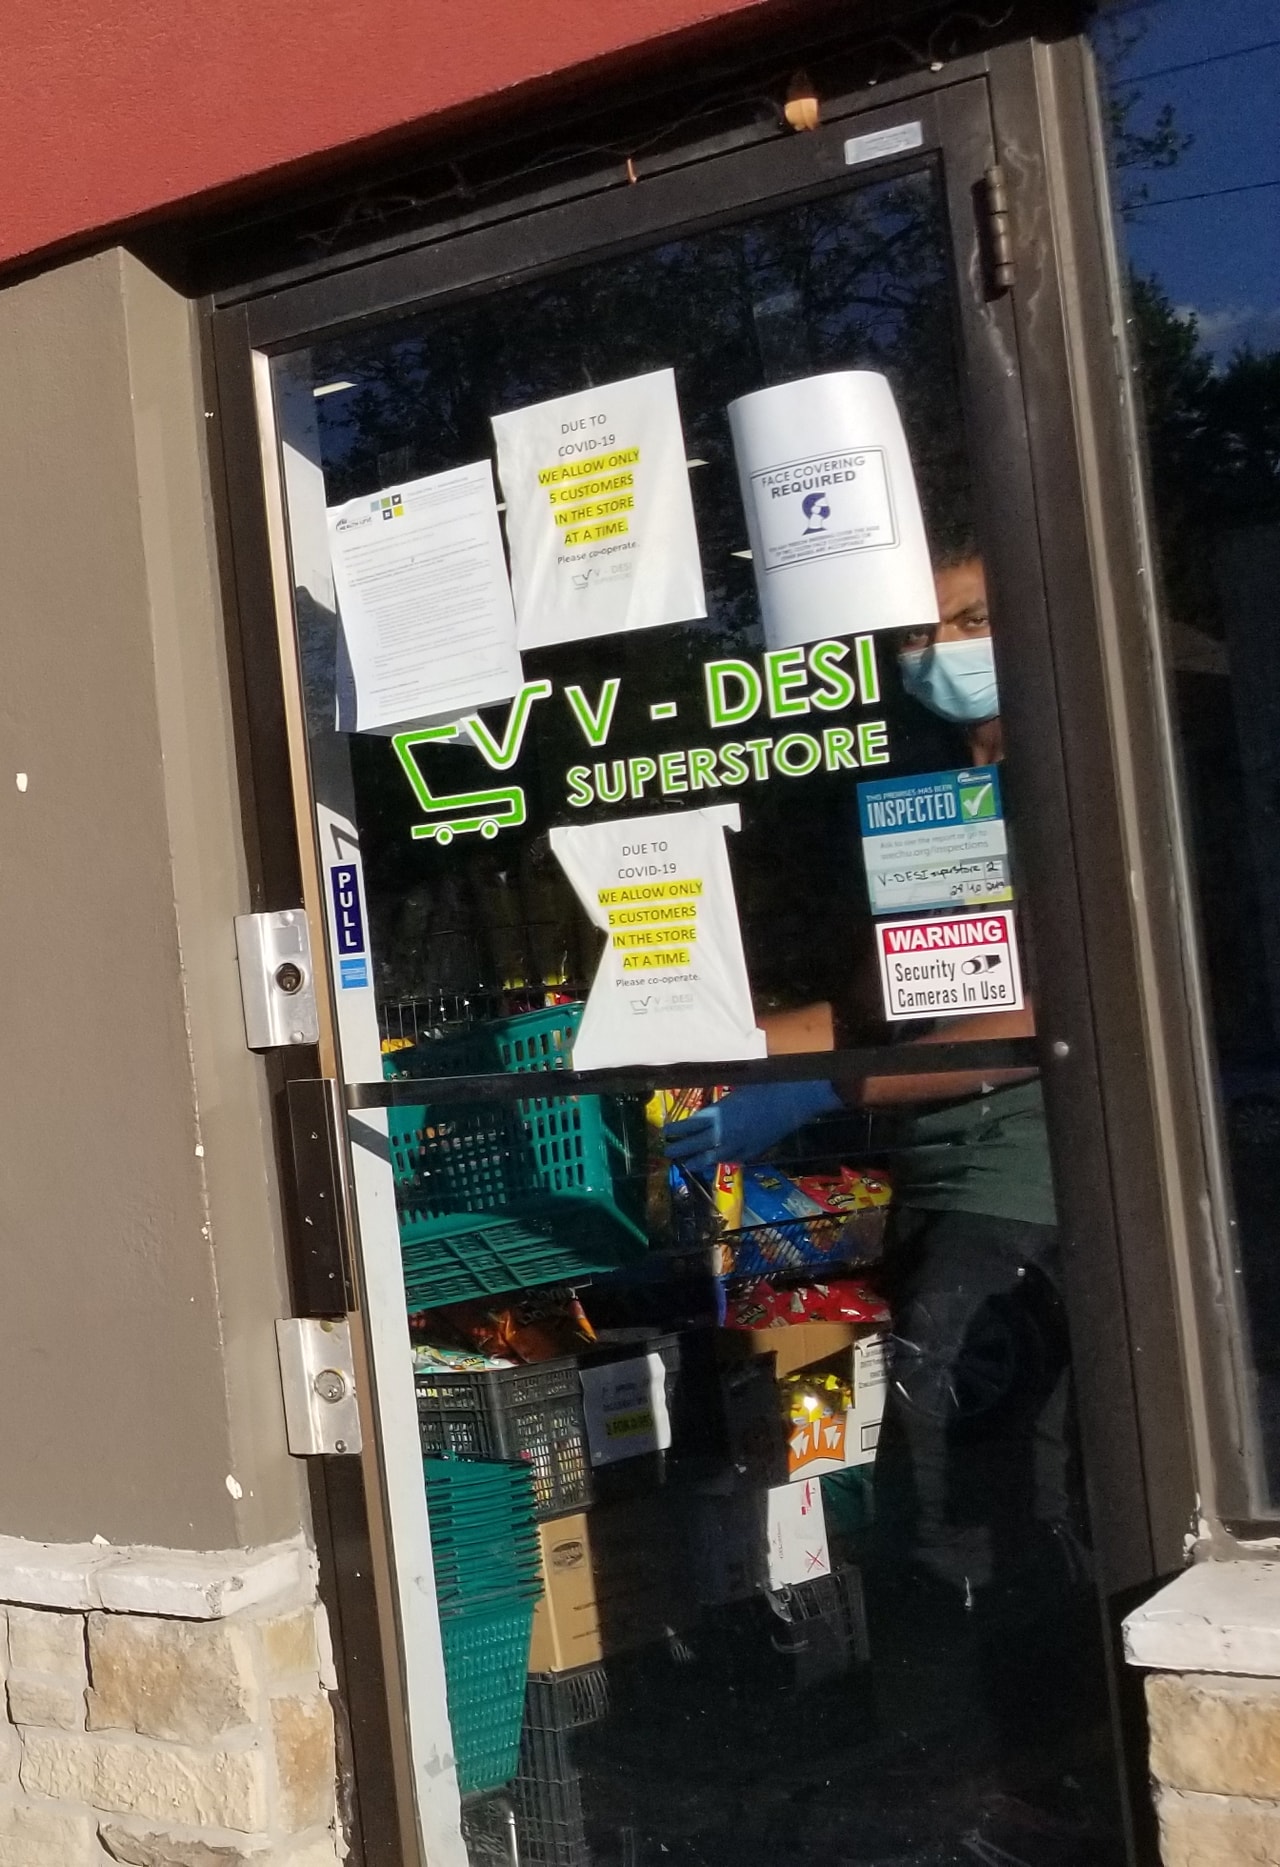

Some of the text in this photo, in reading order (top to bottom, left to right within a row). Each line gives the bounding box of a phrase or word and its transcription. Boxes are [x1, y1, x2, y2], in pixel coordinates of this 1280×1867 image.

[560, 413, 607, 434] DUE TO
[557, 434, 616, 457] COVID-19
[538, 449, 640, 485] WE ALLOW ONLY
[761, 455, 866, 489] FACE COVERING
[560, 473, 634, 501] CUSTOMERS
[771, 470, 857, 499] REQUIRED
[554, 496, 635, 525] IN THE STORE
[564, 521, 629, 545] AT A TIME.
[557, 552, 587, 565] Please
[564, 677, 622, 747] V
[703, 634, 881, 728] DESI
[566, 720, 891, 808] SUPERSTORE
[883, 789, 917, 799] PREMISES
[917, 786, 933, 795] HAS
[934, 783, 953, 793] BEEN
[866, 791, 957, 829] INSPECTED
[622, 841, 668, 857] DUE TO
[618, 862, 677, 879] COVID-19
[598, 881, 703, 903] WE ALLOW ONLY
[338, 872, 358, 947] PULL
[619, 905, 697, 924] CUSTOMERS
[612, 928, 697, 947] IN THE STORE
[888, 920, 1003, 952] WARNING
[623, 952, 691, 968] AT A TIME.
[894, 959, 956, 982] Security
[616, 973, 701, 987] Please co-operate.
[897, 980, 1006, 1008] Cameras In Use
